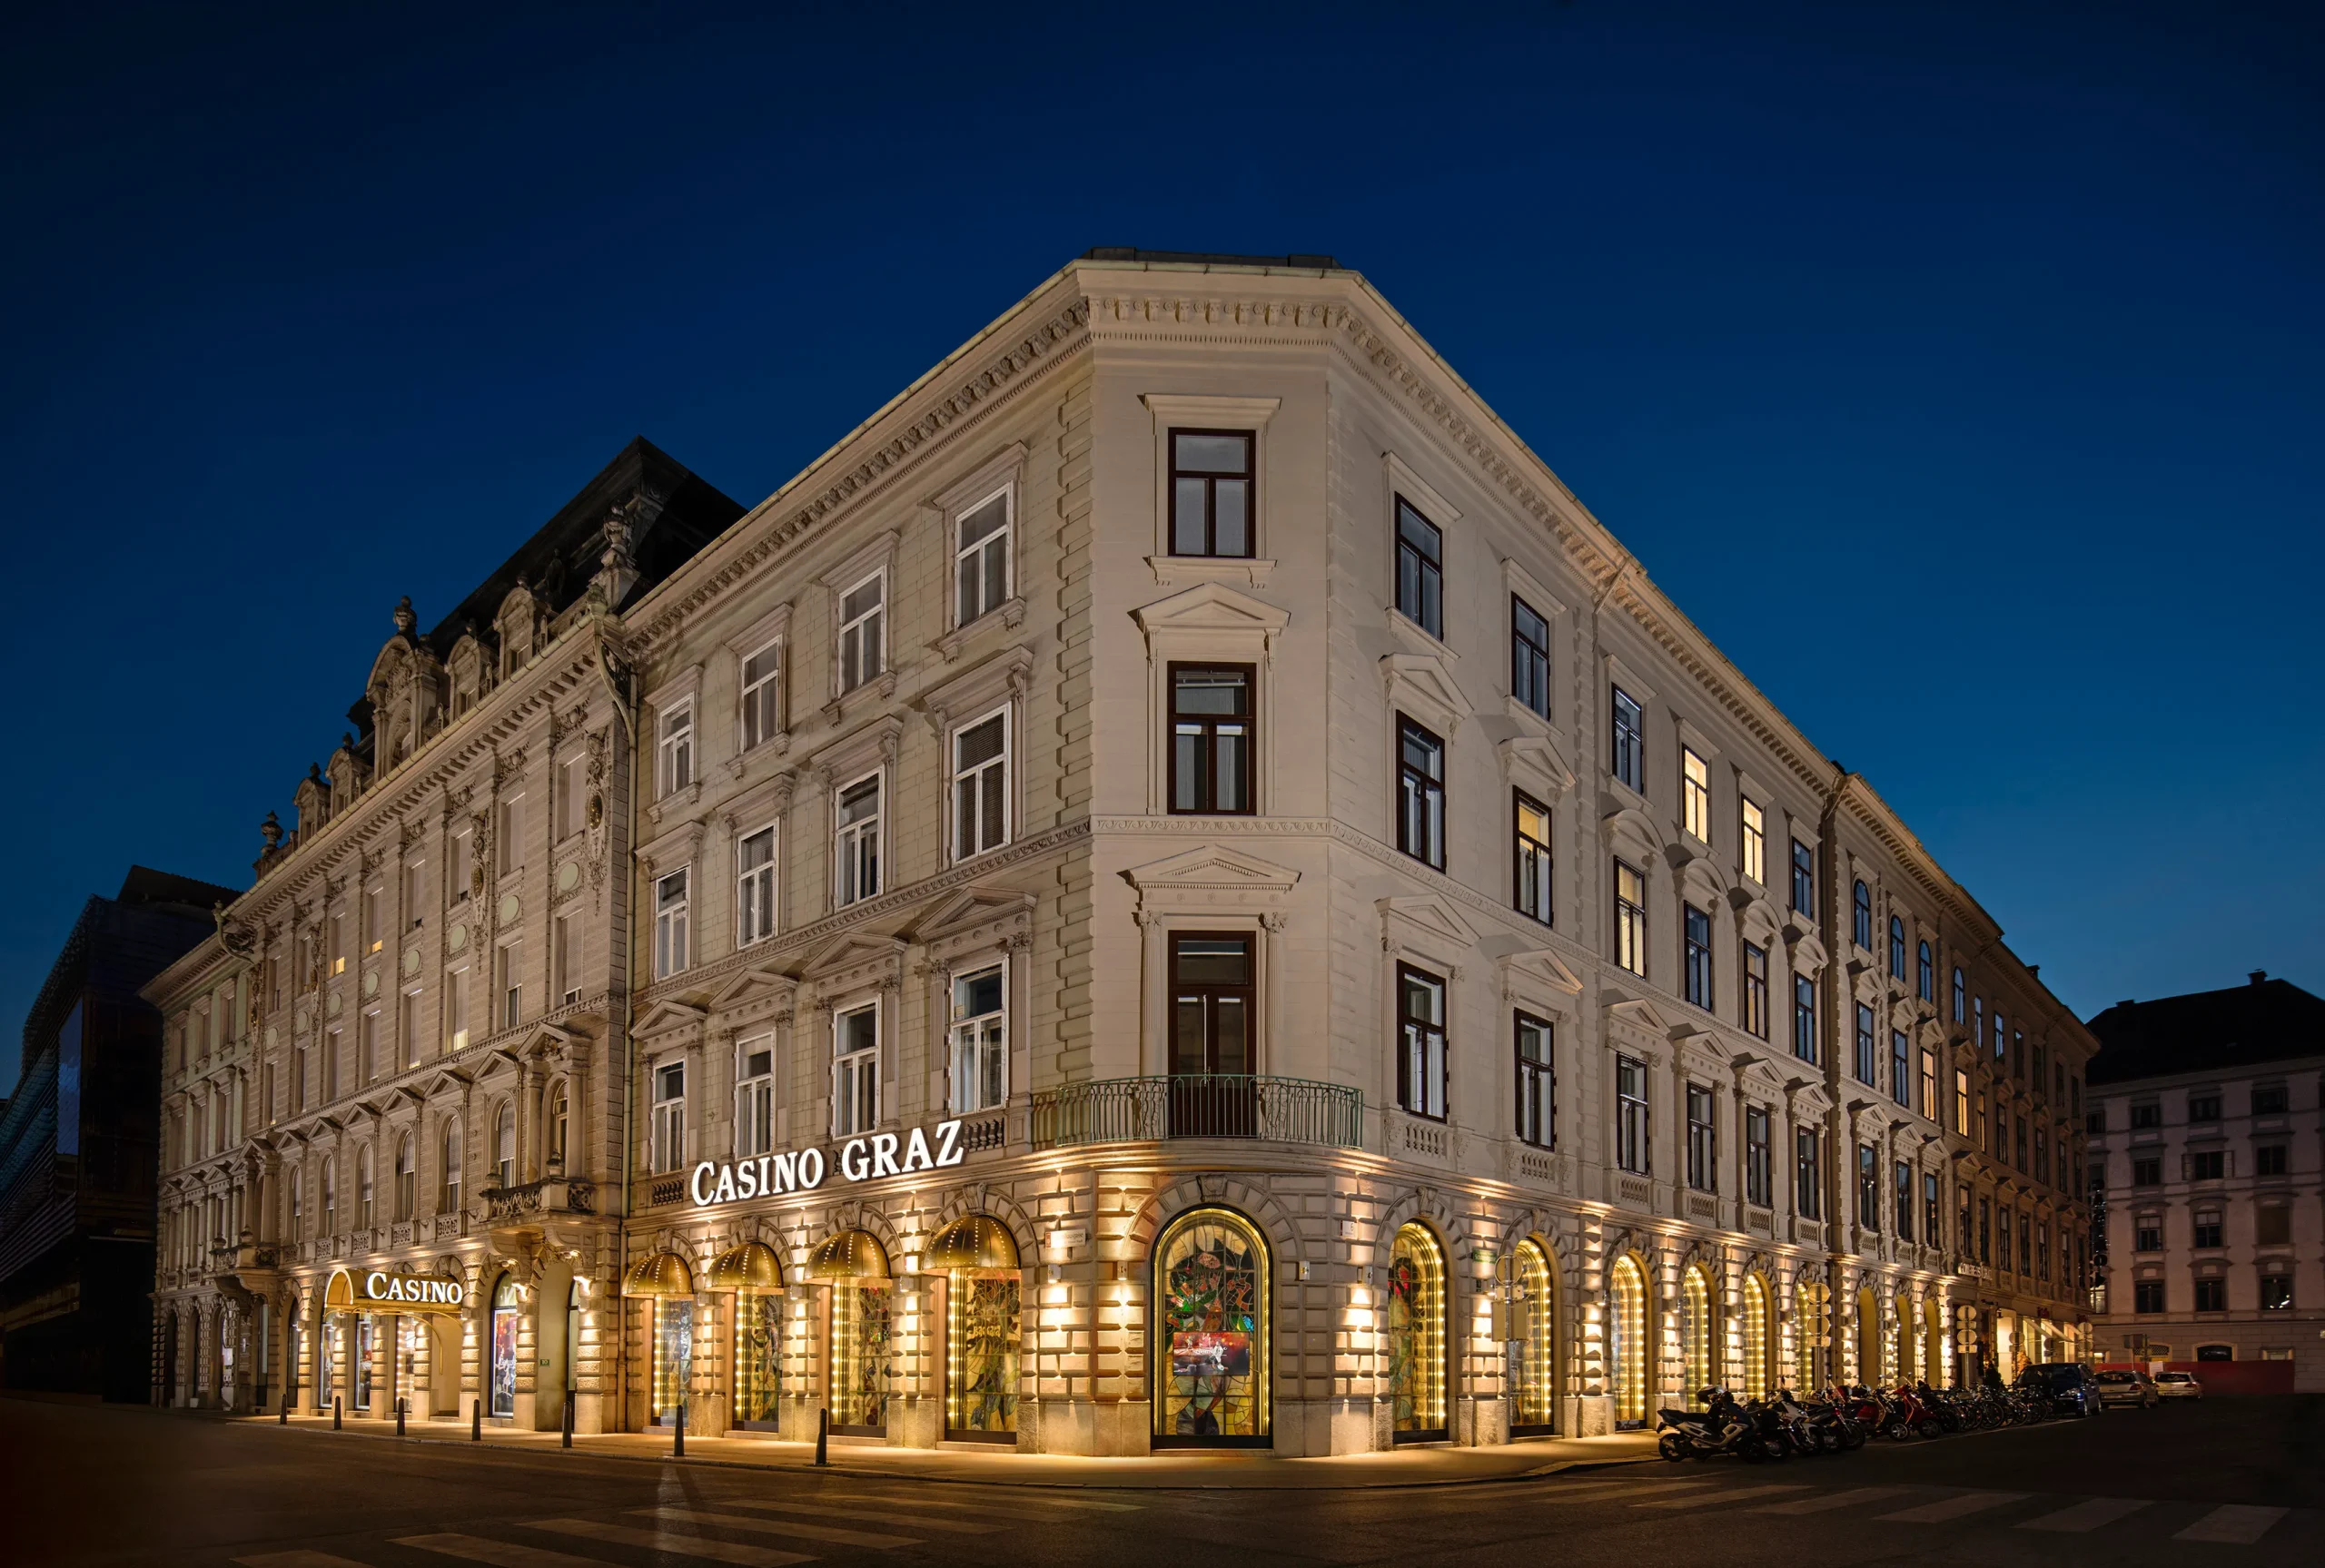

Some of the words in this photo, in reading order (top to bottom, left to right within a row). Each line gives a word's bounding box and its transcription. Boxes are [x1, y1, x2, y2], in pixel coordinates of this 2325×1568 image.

[691, 1148, 825, 1207] CASINO
[841, 1119, 966, 1181] GRAZ
[367, 1272, 463, 1304] CASINO
